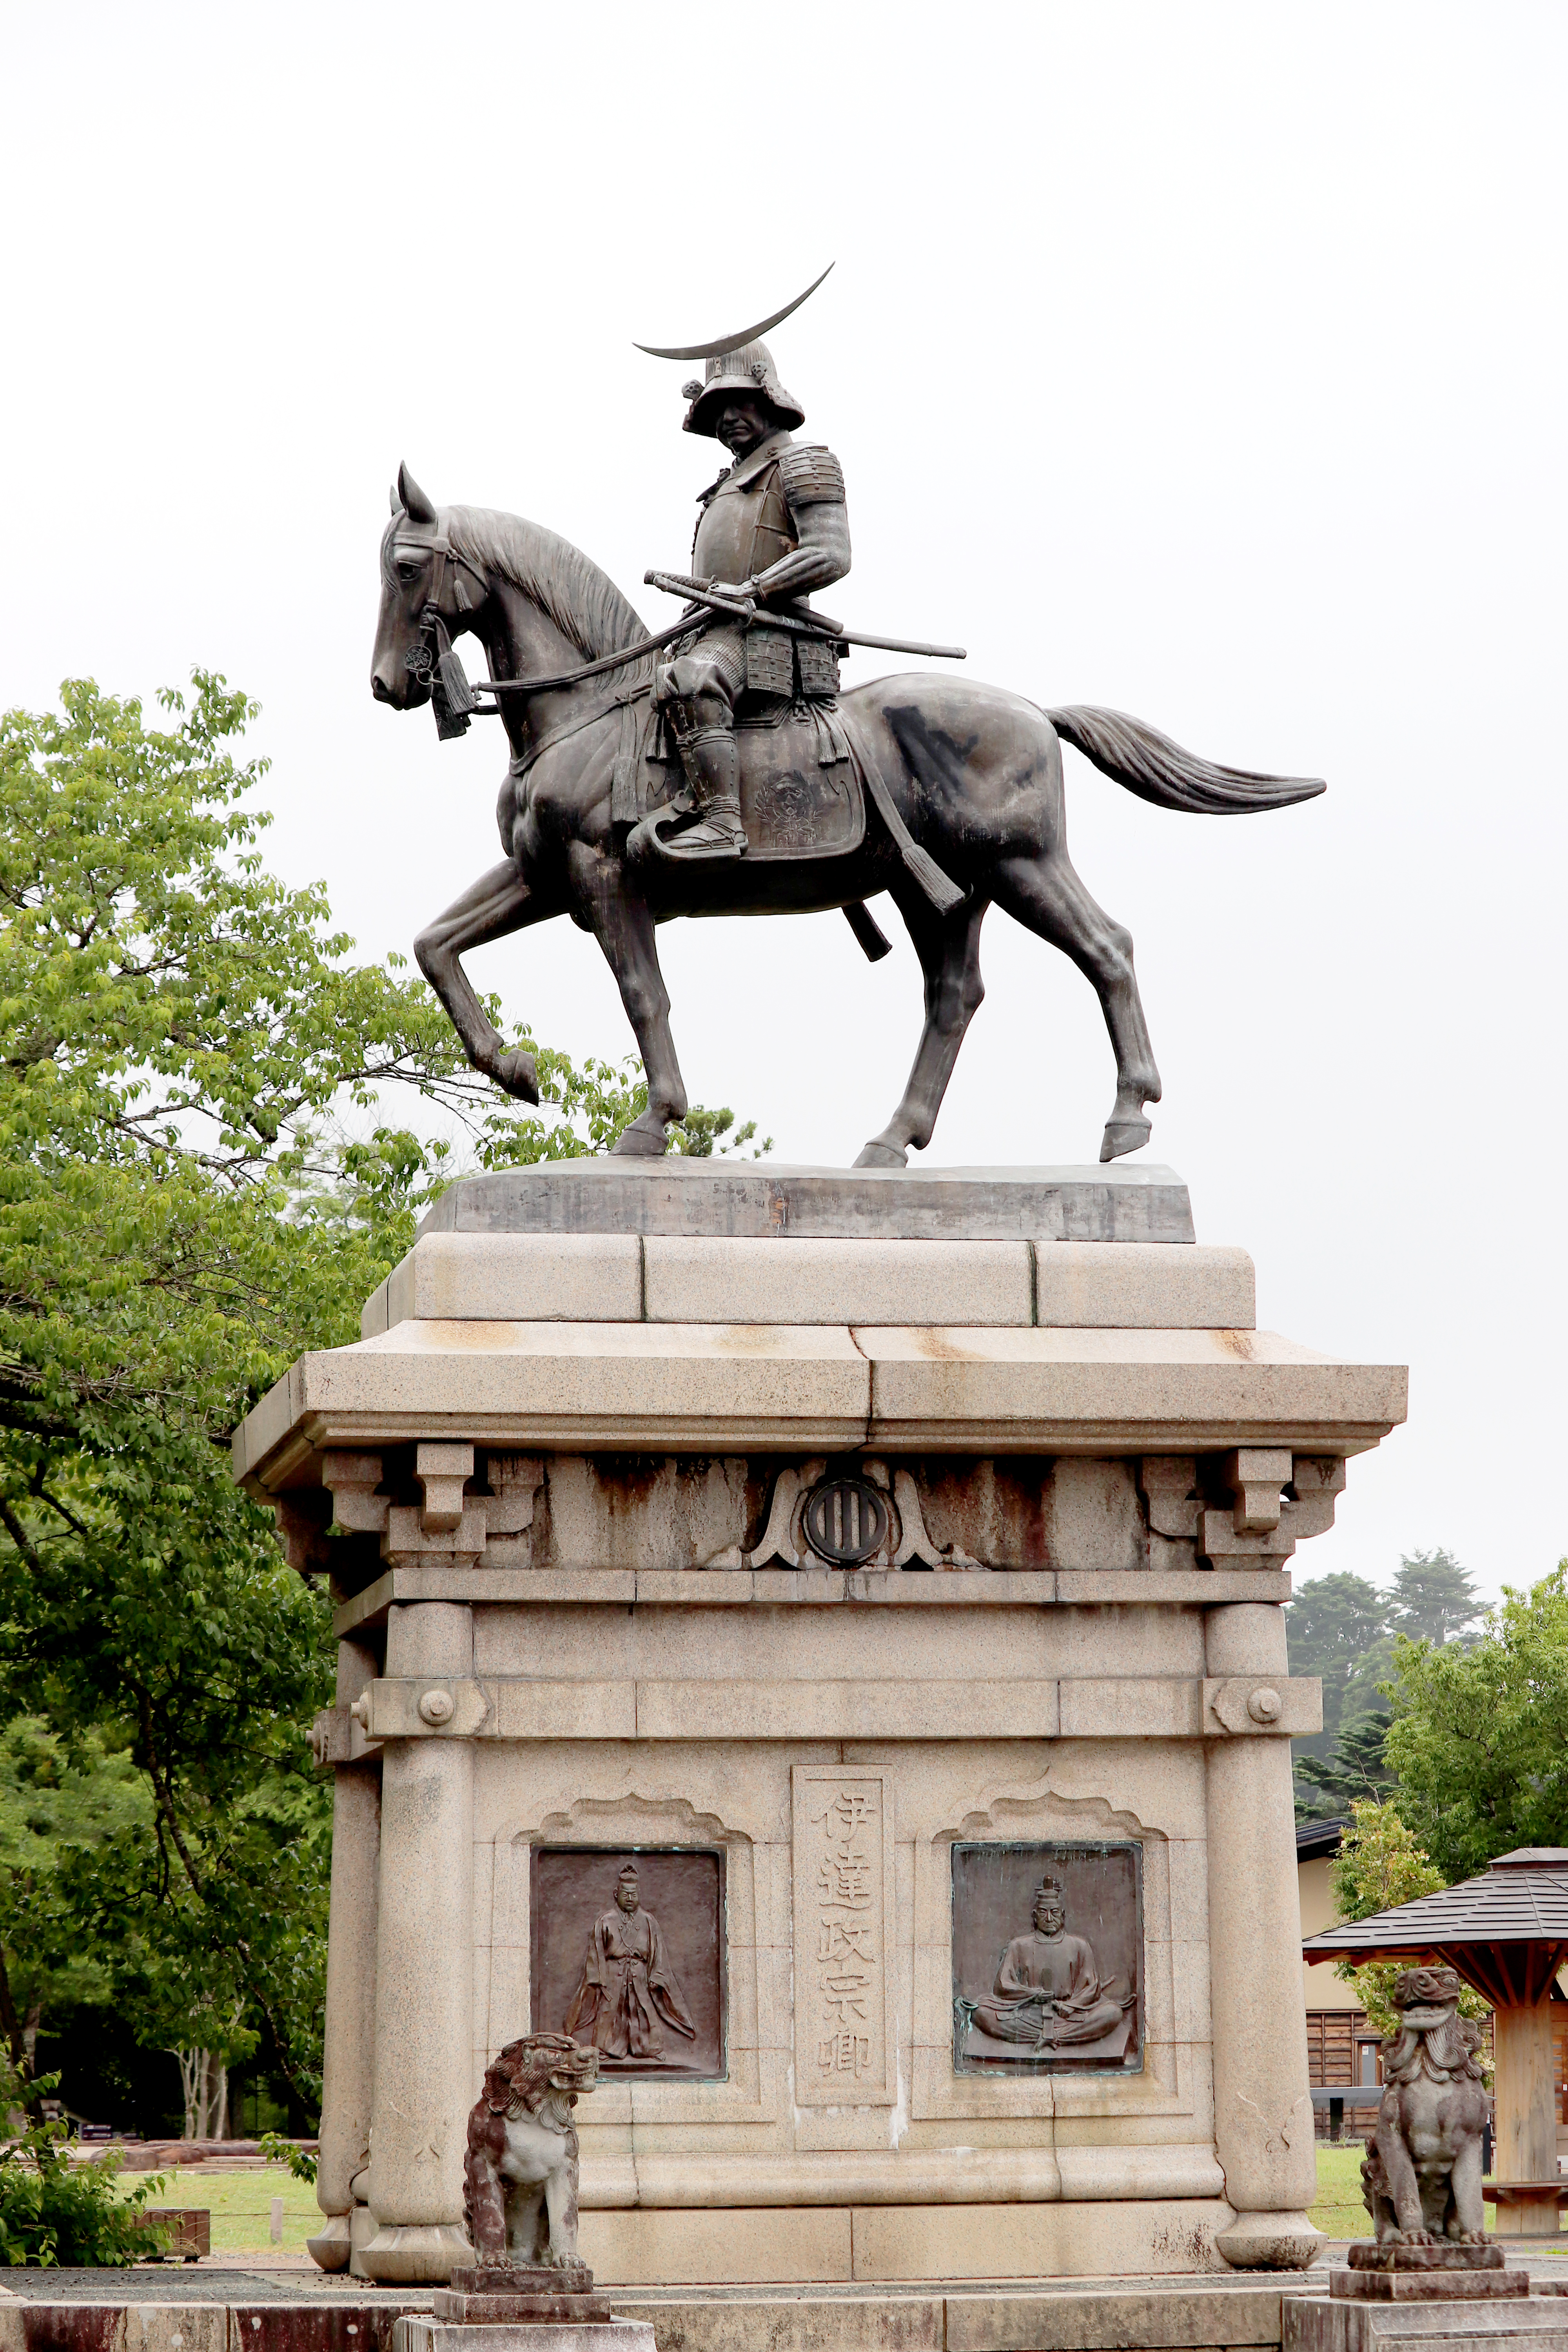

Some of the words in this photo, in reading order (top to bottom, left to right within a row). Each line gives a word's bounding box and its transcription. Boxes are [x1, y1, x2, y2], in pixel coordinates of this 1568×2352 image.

[811, 1792, 876, 2078] 伊達政宗卿
